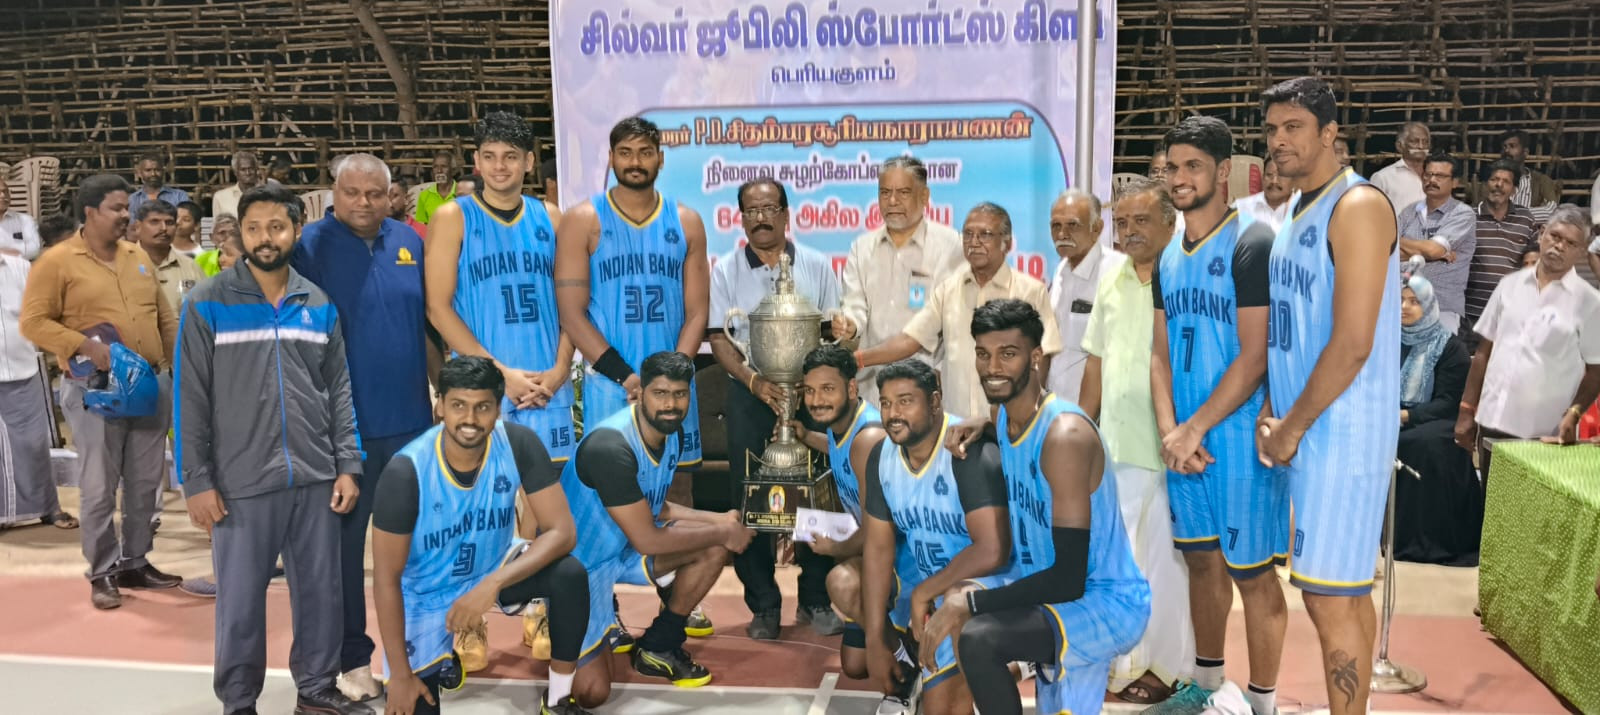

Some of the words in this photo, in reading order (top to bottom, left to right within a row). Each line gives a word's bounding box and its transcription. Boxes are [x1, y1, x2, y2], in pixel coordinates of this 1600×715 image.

[580, 7, 688, 55] சில்வர்
[816, 0, 1006, 47] ஸ்போர்ட்ஸ்
[771, 59, 896, 84] பெரியகுளம்
[796, 200, 860, 227] அகில
[469, 251, 519, 287] INDIAN
[599, 253, 645, 284] INDIAN
[501, 283, 541, 325] 15
[624, 284, 666, 325] 32
[1191, 287, 1233, 326] BANK
[1181, 326, 1196, 374] 7
[550, 425, 571, 449] 15
[923, 505, 969, 536] BANK
[1018, 480, 1050, 529] BANK
[1226, 526, 1240, 551] 7
[451, 541, 477, 577] 9
